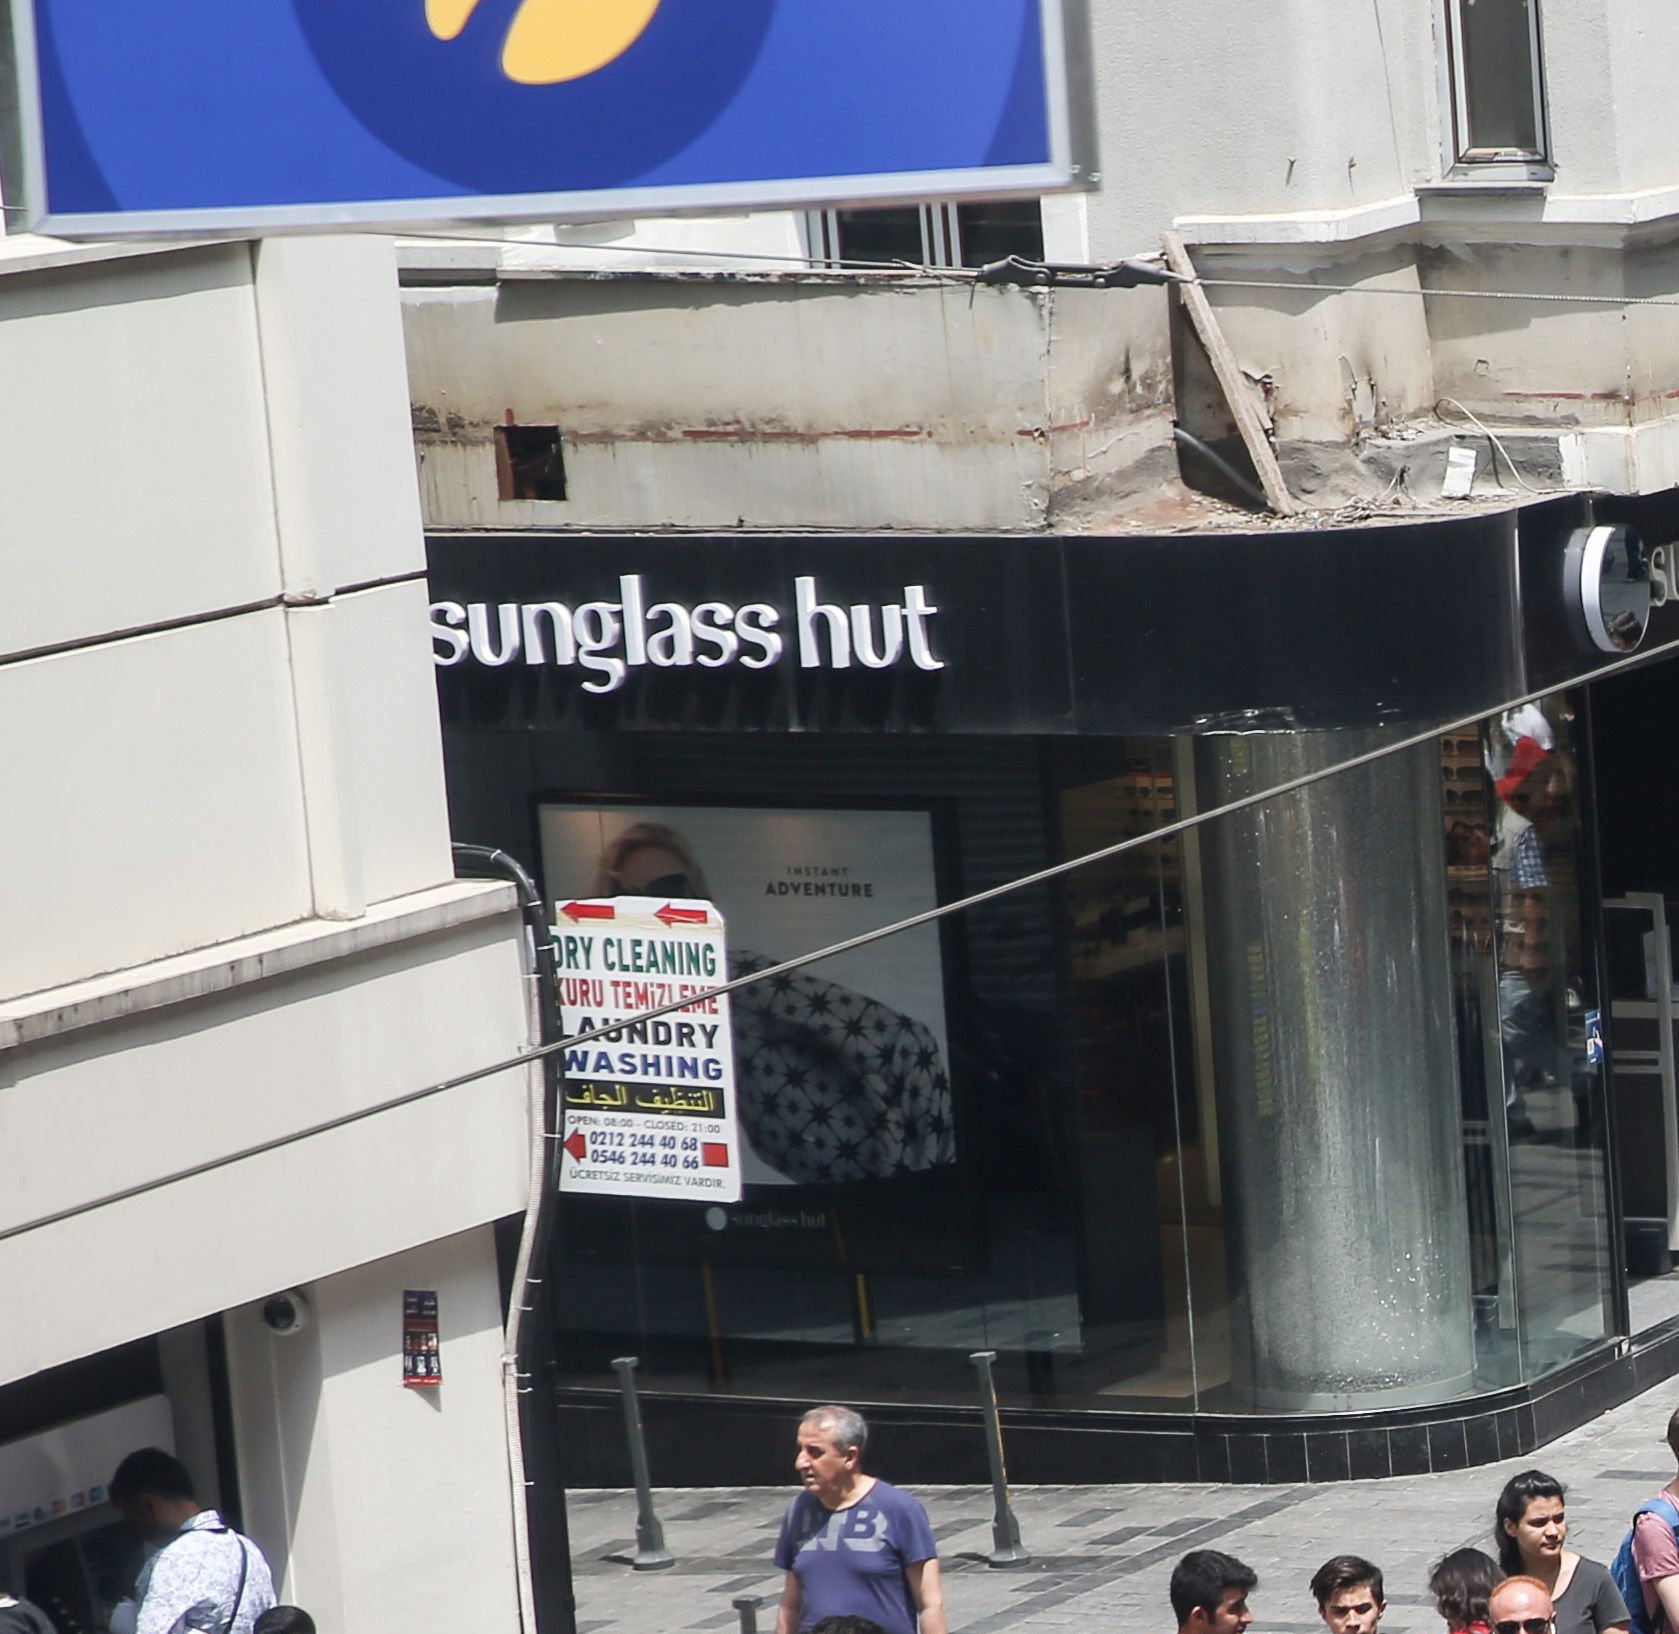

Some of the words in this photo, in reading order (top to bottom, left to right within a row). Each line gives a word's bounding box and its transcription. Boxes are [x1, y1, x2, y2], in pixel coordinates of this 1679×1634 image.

[429, 574, 783, 693] sunglass
[794, 576, 944, 670] hut
[786, 866, 849, 877] INSTANT
[765, 881, 874, 898] ADVENTURE
[550, 934, 593, 970] DRY
[602, 937, 716, 977] CLEANING
[565, 1050, 723, 1081] WASHING
[692, 1123, 721, 1134] 21:00
[589, 1131, 624, 1146] 0212
[629, 1133, 655, 1148] 244
[659, 1135, 676, 1150] 40
[681, 1137, 698, 1151] 68
[591, 1149, 626, 1165] 0546
[630, 1151, 656, 1166] 244
[660, 1154, 677, 1168] 40
[682, 1155, 699, 1170] 66
